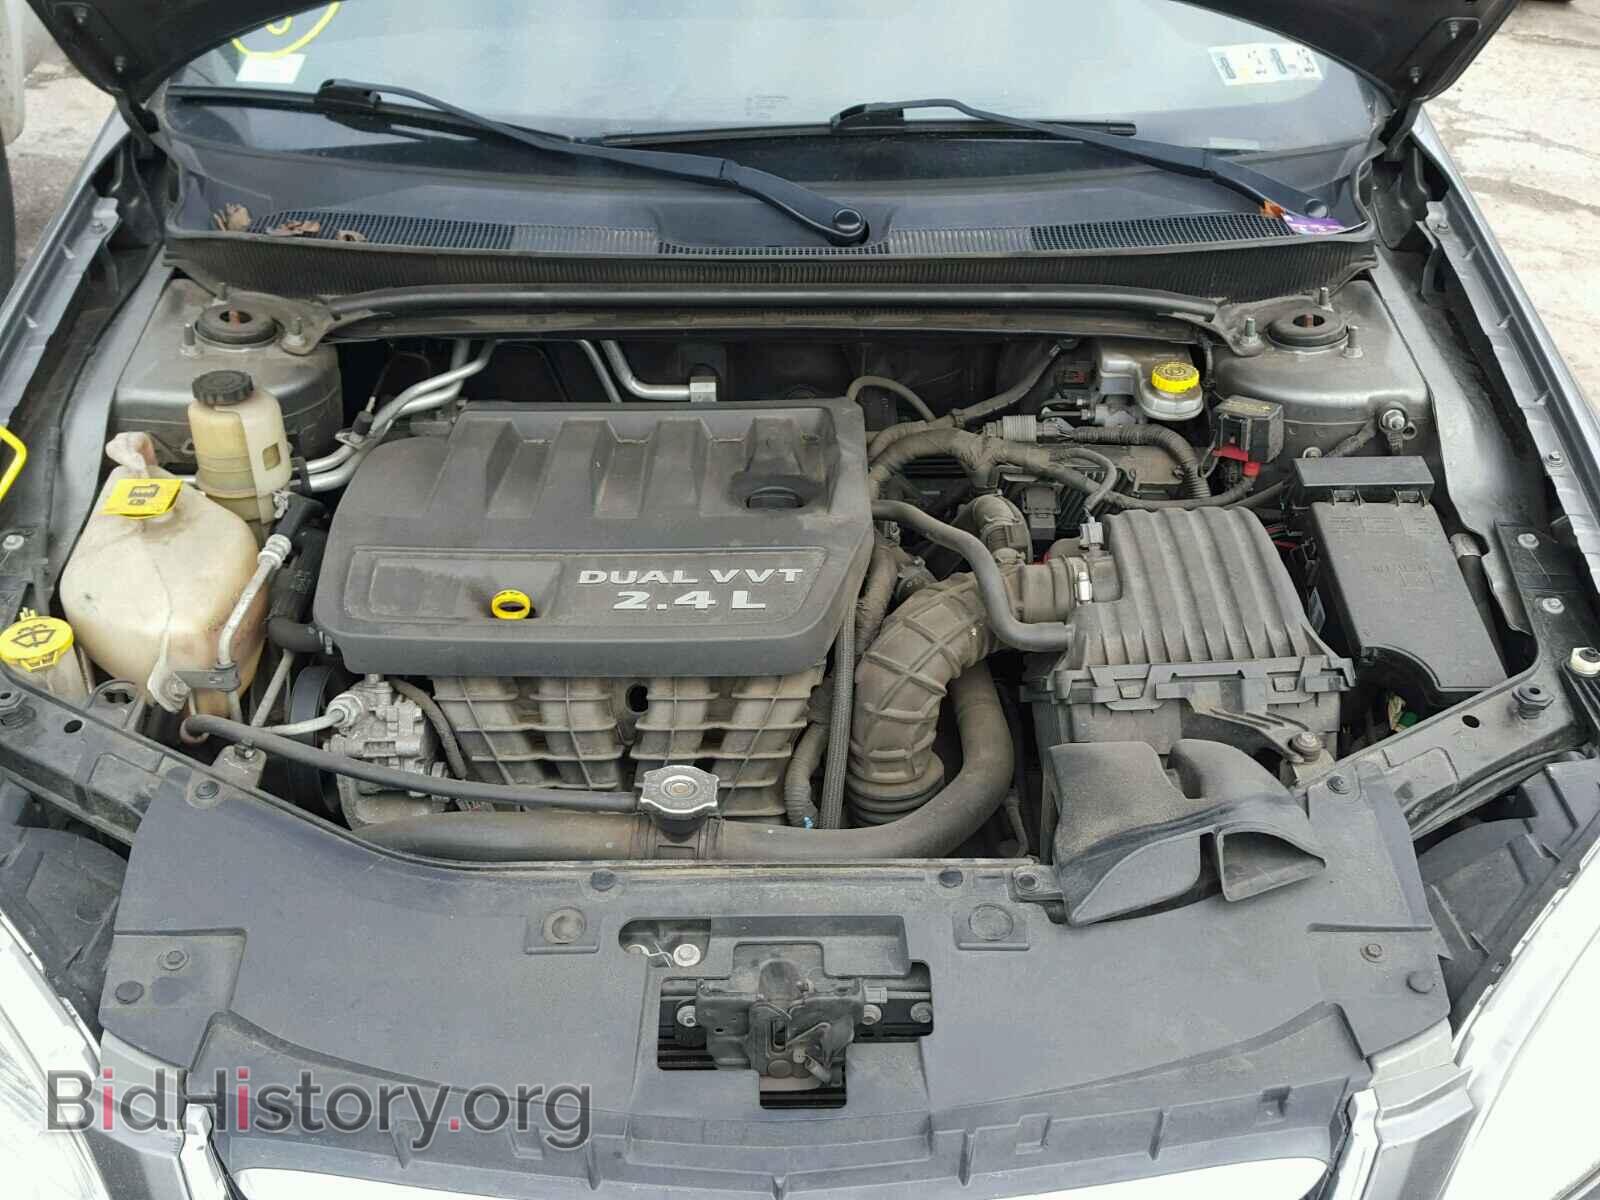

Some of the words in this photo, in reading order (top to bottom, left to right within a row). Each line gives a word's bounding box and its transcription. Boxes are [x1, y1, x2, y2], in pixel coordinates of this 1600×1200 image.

[578, 569, 699, 585] DUAL
[709, 568, 804, 583] VVT
[612, 590, 716, 610] 2.4
